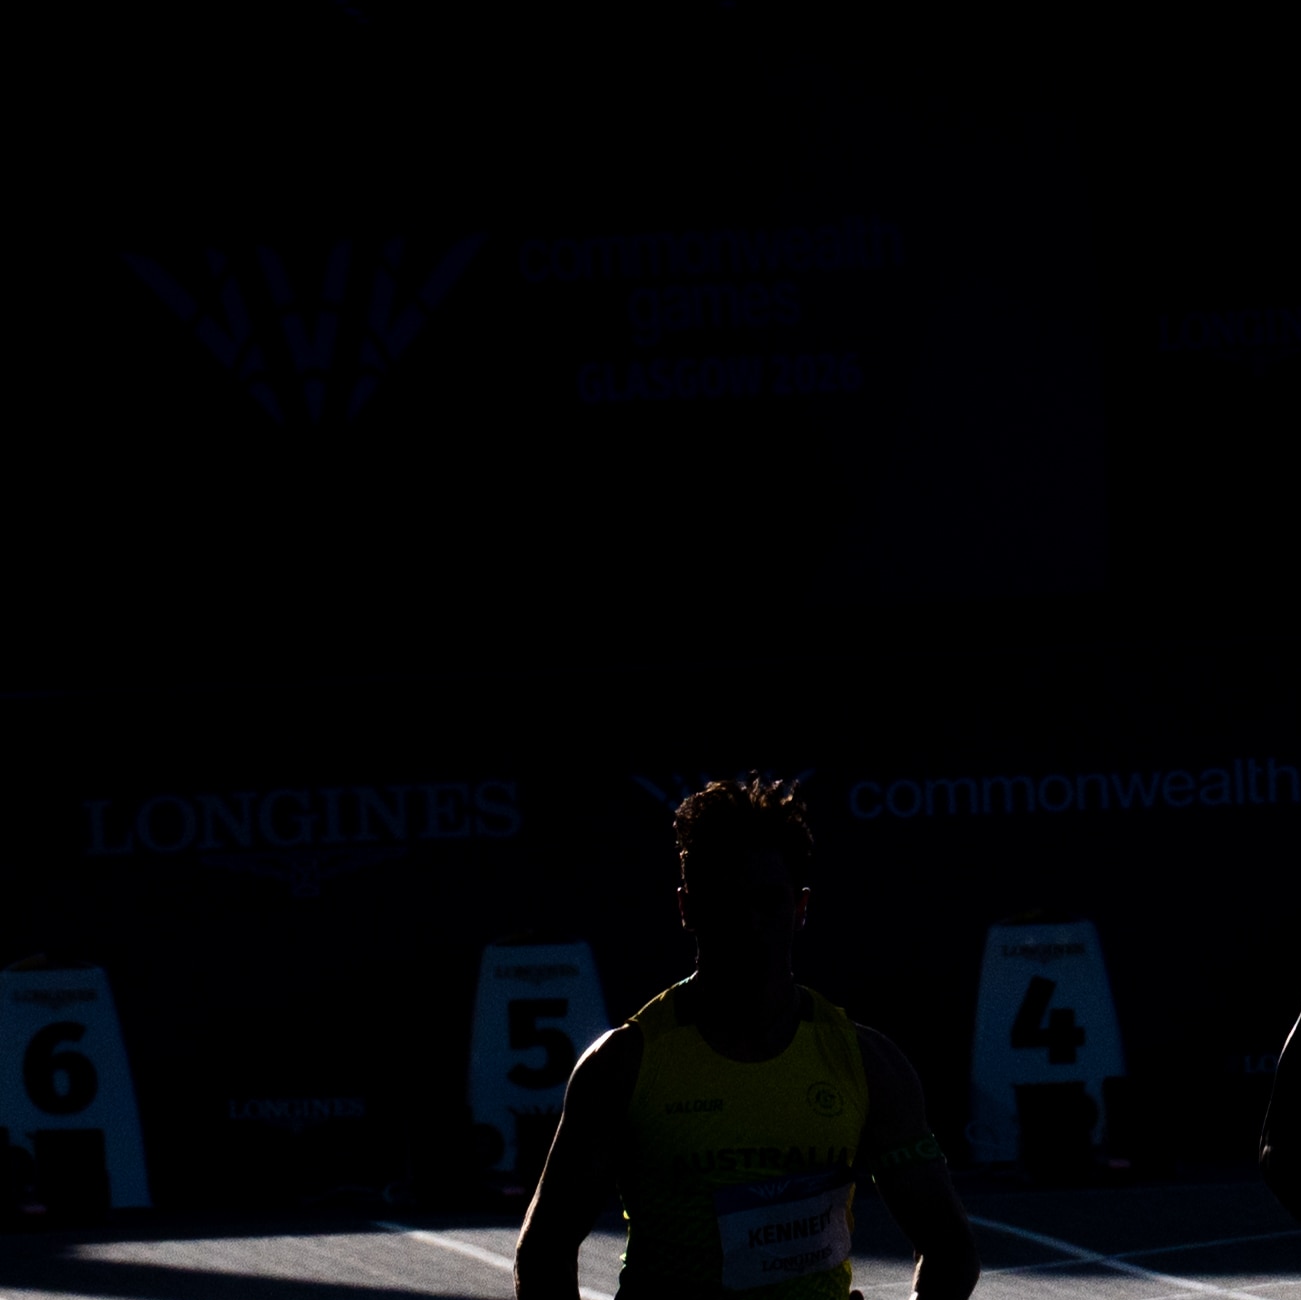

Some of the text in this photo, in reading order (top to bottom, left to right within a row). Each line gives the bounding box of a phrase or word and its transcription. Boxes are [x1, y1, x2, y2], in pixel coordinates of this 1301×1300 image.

[516, 212, 905, 284] commonwealth
[626, 280, 801, 347] games
[575, 352, 865, 404] GLASGOW 2026
[82, 780, 523, 857] LONGINES
[848, 757, 1301, 820] commonwealth
[506, 1000, 577, 1089] 5
[1010, 976, 1085, 1065] 4
[23, 1020, 98, 1116] 6
[228, 1096, 367, 1120] LONGINES
[664, 1099, 723, 1116] VALOUR
